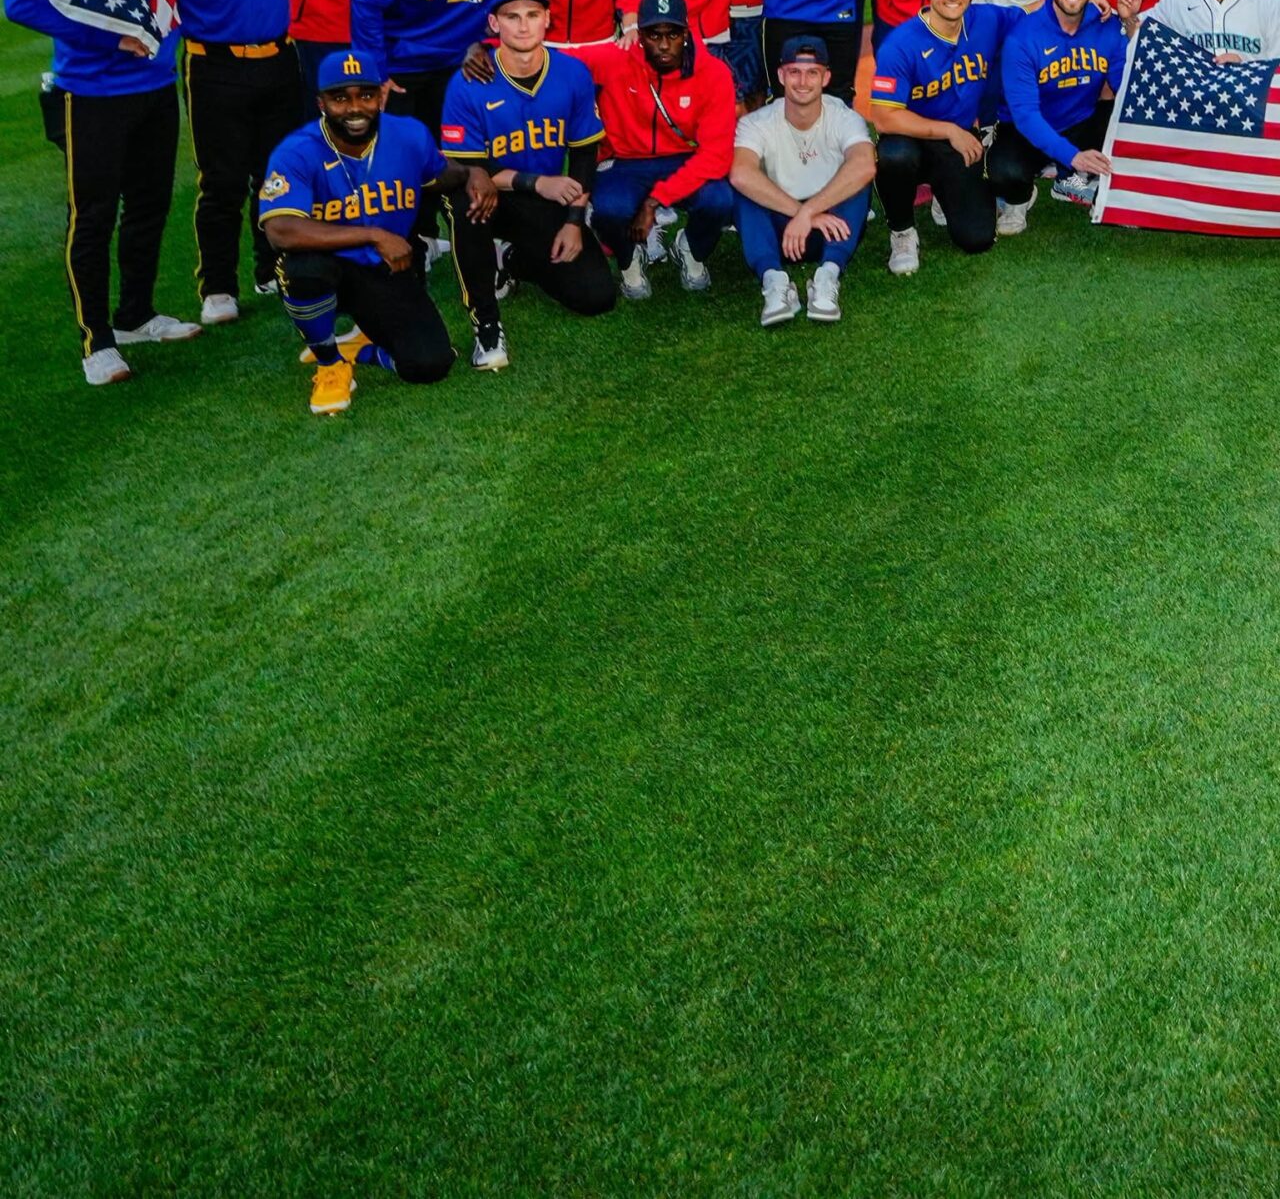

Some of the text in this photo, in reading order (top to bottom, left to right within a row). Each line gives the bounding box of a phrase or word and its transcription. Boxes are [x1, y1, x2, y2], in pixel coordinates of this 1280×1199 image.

[1039, 47, 1108, 84] seattle
[486, 118, 566, 159] eattl
[311, 180, 415, 222] seattle
